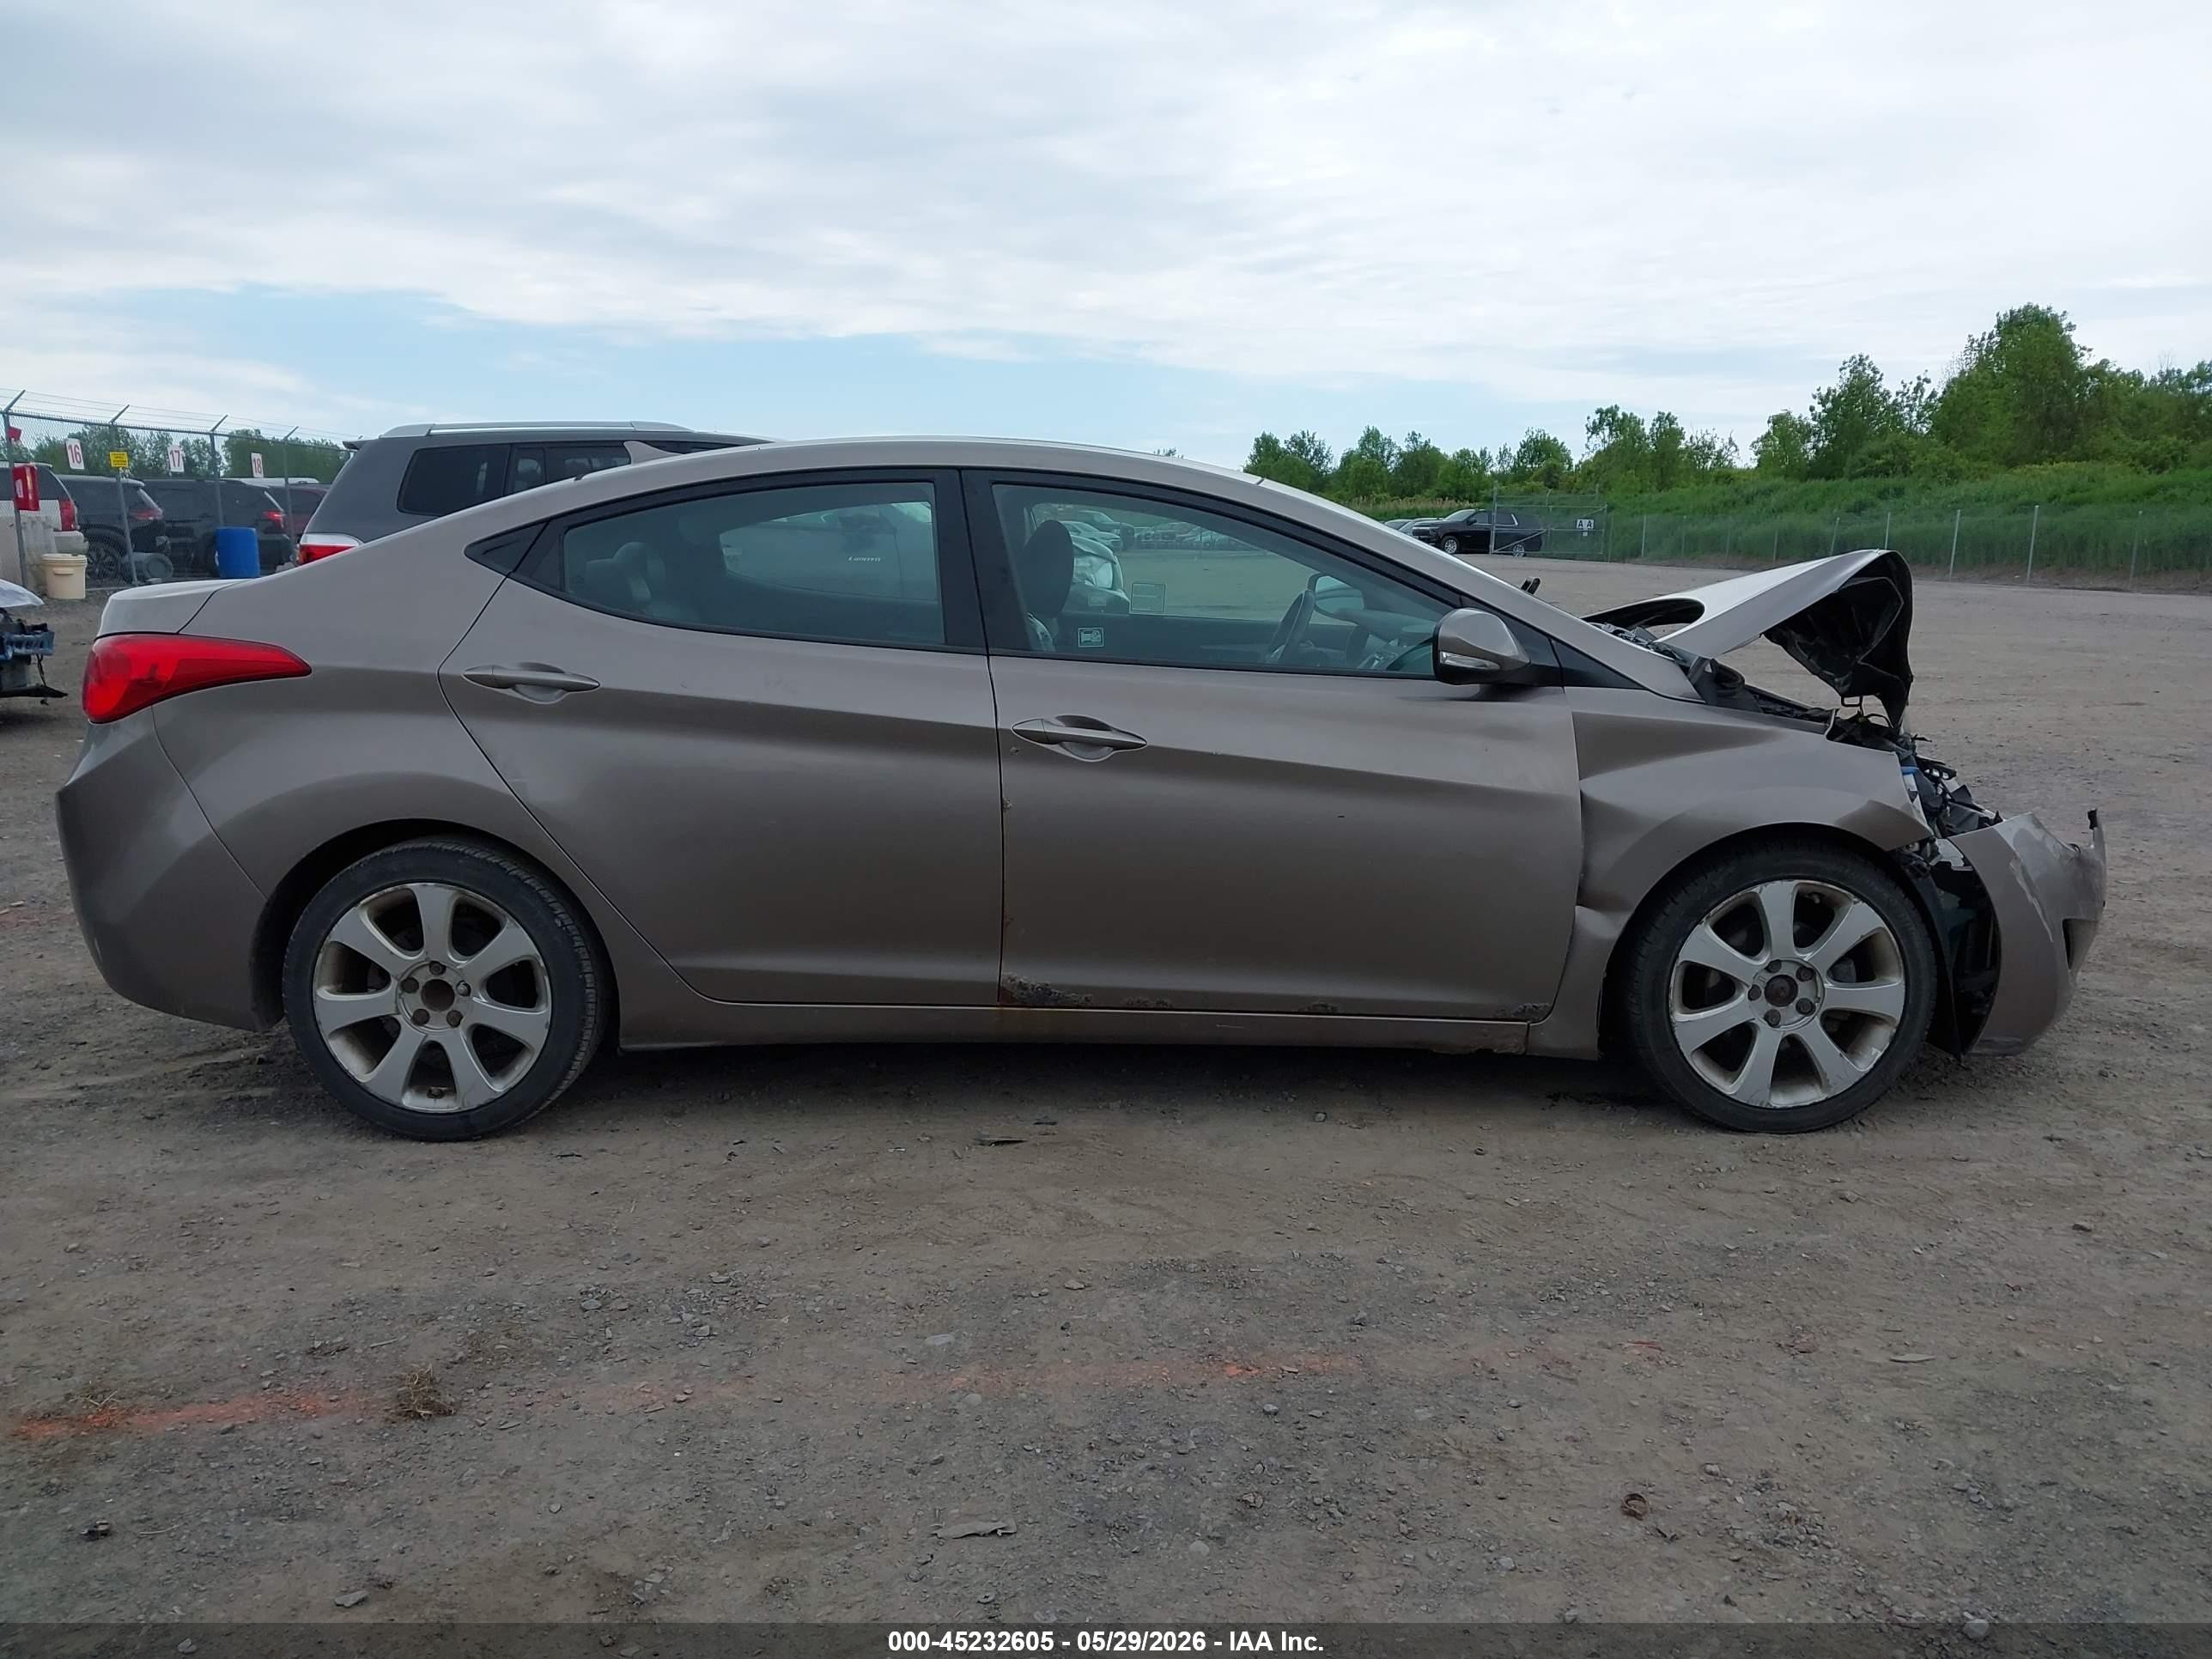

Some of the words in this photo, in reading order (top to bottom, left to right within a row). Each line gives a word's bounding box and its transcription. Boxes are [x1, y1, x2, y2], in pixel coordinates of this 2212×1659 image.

[68, 444, 82, 465] 16
[169, 449, 180, 468] 17
[253, 458, 262, 474] 18
